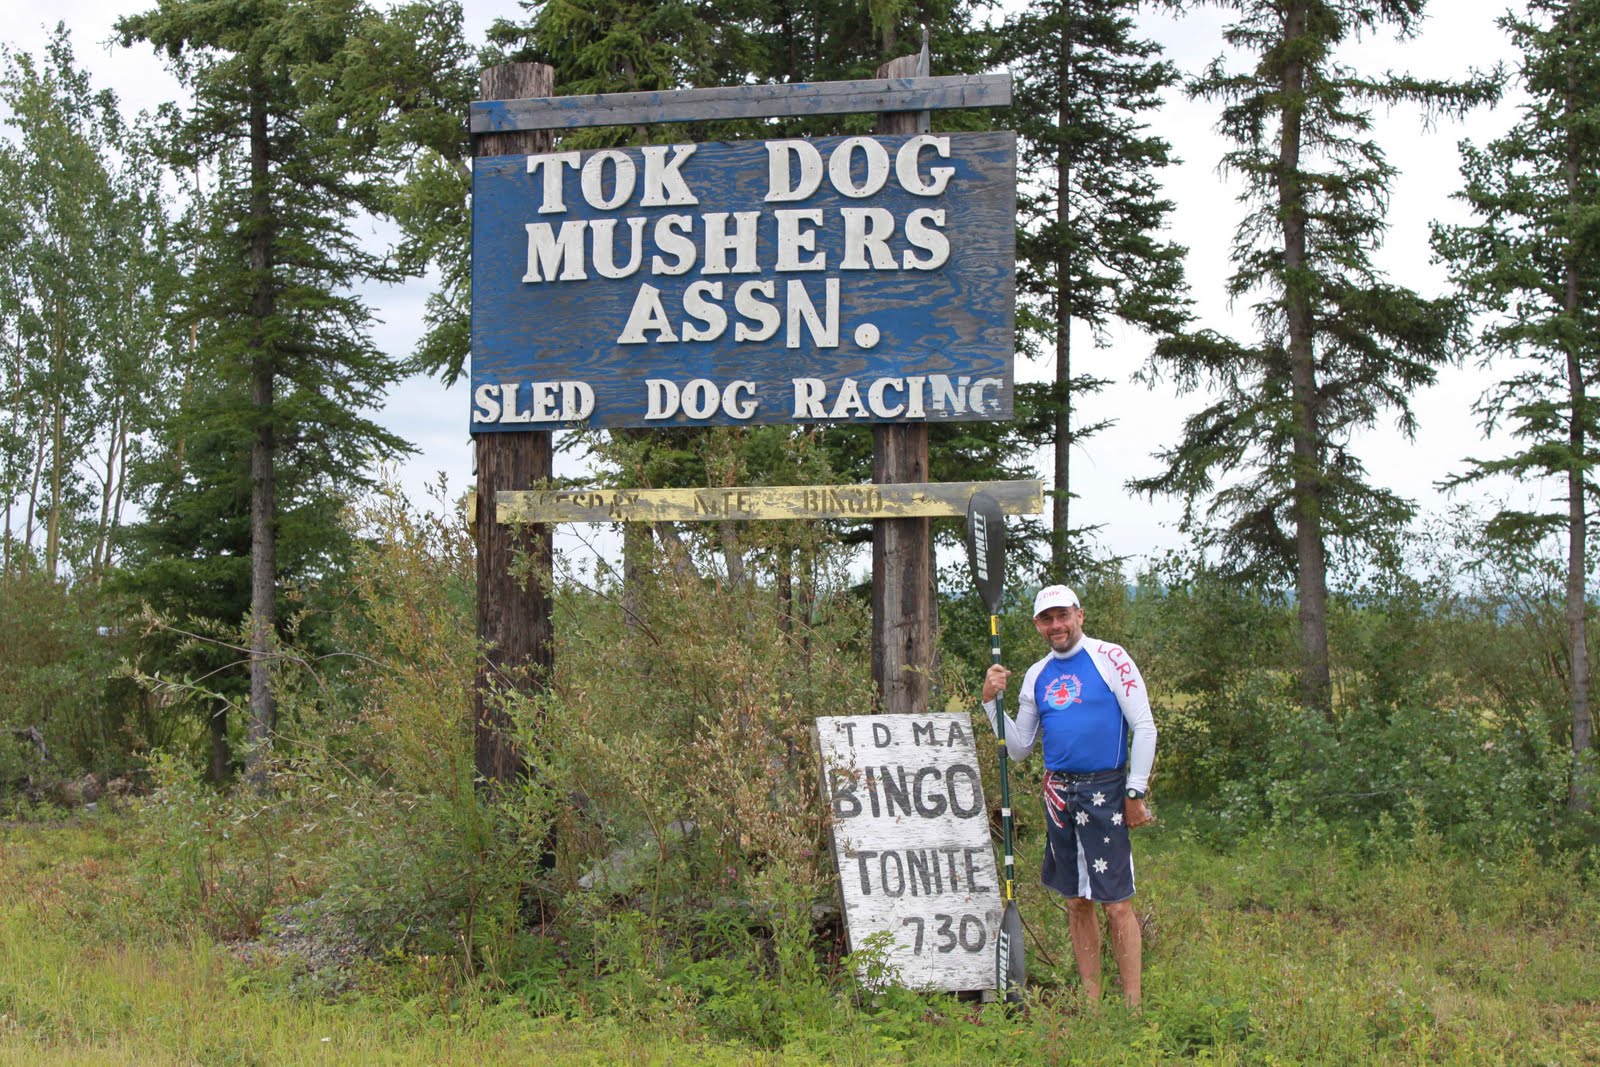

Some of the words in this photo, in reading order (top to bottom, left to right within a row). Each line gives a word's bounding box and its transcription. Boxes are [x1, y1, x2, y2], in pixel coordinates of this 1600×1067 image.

[526, 143, 698, 214] TOK
[764, 134, 956, 203] DOG
[522, 207, 951, 283] MUSHERS
[617, 278, 881, 349] ASSN.
[472, 380, 596, 425] SLED
[644, 378, 760, 420] DOG
[792, 374, 1004, 419] RACING
[803, 489, 884, 514] BINGO
[973, 510, 989, 581] BENNETT
[829, 764, 984, 820] BINGO
[851, 847, 991, 897] TONITE
